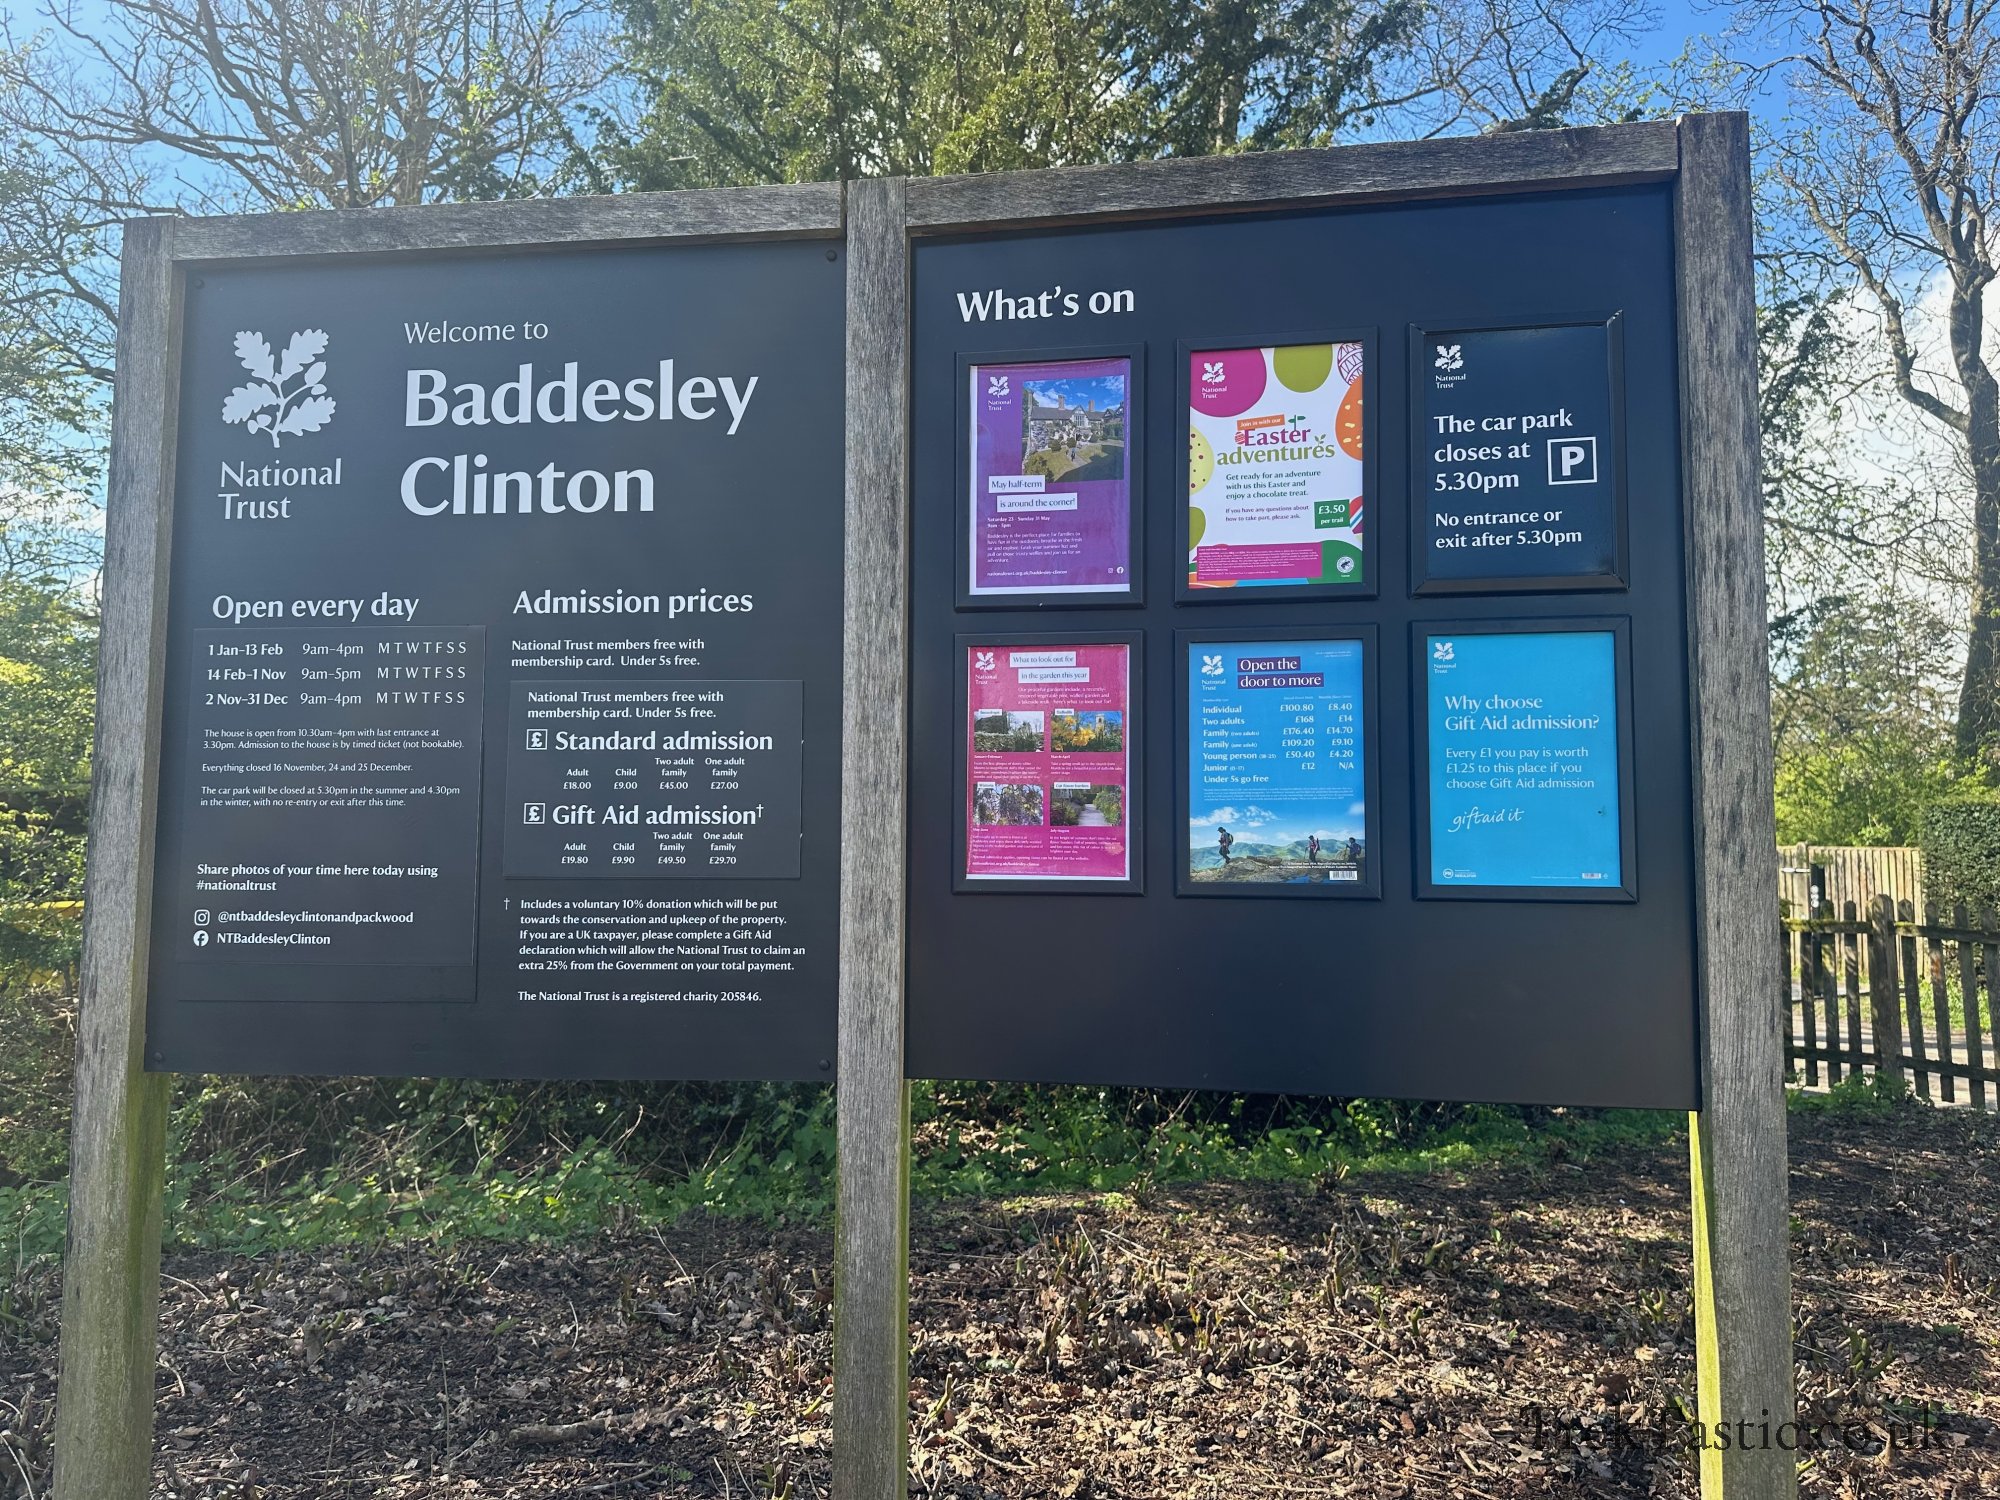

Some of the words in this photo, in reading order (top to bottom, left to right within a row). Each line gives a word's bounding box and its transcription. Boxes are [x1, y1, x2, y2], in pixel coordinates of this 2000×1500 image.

[1088, 289, 1134, 315] on
[403, 320, 516, 344] Welcome
[523, 321, 549, 340] to
[405, 358, 759, 436] Baddesley
[1201, 385, 1228, 394] National
[1433, 414, 1476, 434] The
[1481, 416, 1517, 432] car
[1521, 408, 1573, 433] park
[1244, 427, 1312, 447] Easter
[1216, 444, 1336, 466] adventures
[1434, 443, 1502, 463] closes
[1507, 442, 1531, 459] at
[1561, 446, 1585, 477] P
[220, 457, 342, 488] National
[1225, 473, 1239, 481] Get
[1240, 472, 1261, 481] ready
[1262, 471, 1273, 479] for
[1284, 470, 1322, 478] adventure
[400, 453, 654, 516] Clinton
[991, 480, 1007, 489] May
[1008, 479, 1043, 488] half-term
[1434, 471, 1519, 494] 5.30pm
[217, 493, 291, 520] Trust
[1000, 500, 1006, 508] is
[1007, 498, 1034, 508] around
[1035, 498, 1048, 507] the
[1048, 497, 1076, 507] corner!
[1318, 504, 1346, 515] £3.50
[1435, 512, 1460, 527] No
[1463, 512, 1539, 526] entrance
[1543, 510, 1563, 522] or
[1435, 533, 1468, 549] exit
[1471, 531, 1514, 547] after
[1516, 529, 1582, 547] 5.30pm
[212, 595, 284, 625] Open
[291, 599, 365, 623] every
[370, 591, 420, 622] day
[512, 588, 660, 614] Admission
[668, 587, 753, 619] prices
[208, 644, 214, 656] 1
[261, 643, 284, 656] Feb
[1038, 655, 1053, 663] look
[1064, 655, 1074, 663] for
[1239, 659, 1275, 674] Open
[1277, 657, 1298, 670] the
[207, 668, 221, 681] 14
[261, 668, 287, 680] Nov
[1039, 671, 1061, 681] garden
[1061, 671, 1074, 679] this
[1073, 672, 1088, 680] year
[1240, 675, 1270, 688] door
[1272, 676, 1286, 687] to
[1288, 676, 1322, 686] more
[205, 693, 214, 705] 2
[263, 693, 289, 705] Dec
[528, 691, 578, 703] National
[580, 691, 612, 702] Trust
[614, 691, 669, 702] members
[671, 690, 695, 702] free
[697, 690, 724, 702] with
[1444, 694, 1482, 713] Why
[1485, 694, 1543, 710] choose
[527, 707, 601, 721] membership
[602, 706, 632, 718] card.
[635, 706, 672, 718] Under
[674, 707, 687, 718] 5s
[690, 706, 717, 718] free.
[1202, 705, 1242, 714] Individual
[1279, 703, 1314, 712] £100.80
[1328, 702, 1353, 711] £8.40
[1445, 715, 1476, 731] Gift
[1479, 714, 1508, 730] Aid
[1511, 714, 1600, 730] admission?
[204, 729, 220, 738] The
[220, 728, 245, 738] house
[246, 728, 253, 738] is
[254, 730, 275, 739] open
[276, 728, 297, 737] from
[356, 728, 375, 737] with
[376, 728, 392, 737] last
[393, 729, 430, 737] entrance
[431, 729, 440, 737] at
[555, 730, 656, 751] Standard
[662, 730, 773, 751] admission
[202, 763, 245, 774] Everything
[245, 763, 272, 772] closed
[273, 763, 282, 772] 16
[283, 762, 327, 772] November,
[328, 762, 339, 772] 24
[340, 762, 356, 772] and
[357, 762, 368, 772] 25
[369, 762, 413, 772] December.
[566, 768, 589, 777] Adult
[615, 768, 637, 777] Child
[1446, 762, 1475, 774] £1.25
[1478, 764, 1491, 773] to
[1493, 762, 1515, 773] this
[1517, 762, 1547, 775] place
[1550, 761, 1559, 773] if
[1560, 764, 1582, 775] you
[563, 781, 592, 790] £18.00
[613, 781, 638, 790] £9.00
[659, 781, 689, 790] £45.00
[710, 781, 739, 790] £27.00
[1203, 775, 1229, 783] Under
[1230, 775, 1240, 783] 5s
[1240, 776, 1252, 785] go
[1252, 774, 1269, 783] free
[552, 804, 596, 825] Gift
[601, 804, 639, 825] Aid
[1507, 807, 1525, 822] it
[561, 855, 589, 864] £19.80
[611, 856, 635, 864] £9.90
[657, 856, 686, 865] £49.50
[709, 856, 737, 865] £29.70
[196, 863, 229, 875] Share
[231, 863, 270, 877] photos
[272, 863, 286, 875] of
[287, 866, 314, 878] your
[315, 864, 342, 876] time
[343, 864, 370, 876] here
[372, 864, 405, 878] today
[407, 864, 439, 878] using
[196, 879, 277, 891] #nationaltrust
[217, 910, 414, 925] @ntbaddesleyclintonandpackwood
[216, 932, 331, 947] NTBaddesleyClinton
[517, 990, 537, 1001] The
[538, 991, 582, 1001] National
[583, 991, 610, 1001] Trust
[612, 991, 621, 1001] is
[622, 993, 629, 1001] a
[630, 991, 681, 1004] registered
[682, 991, 719, 1004] charity
[720, 991, 762, 1002] 205846.
